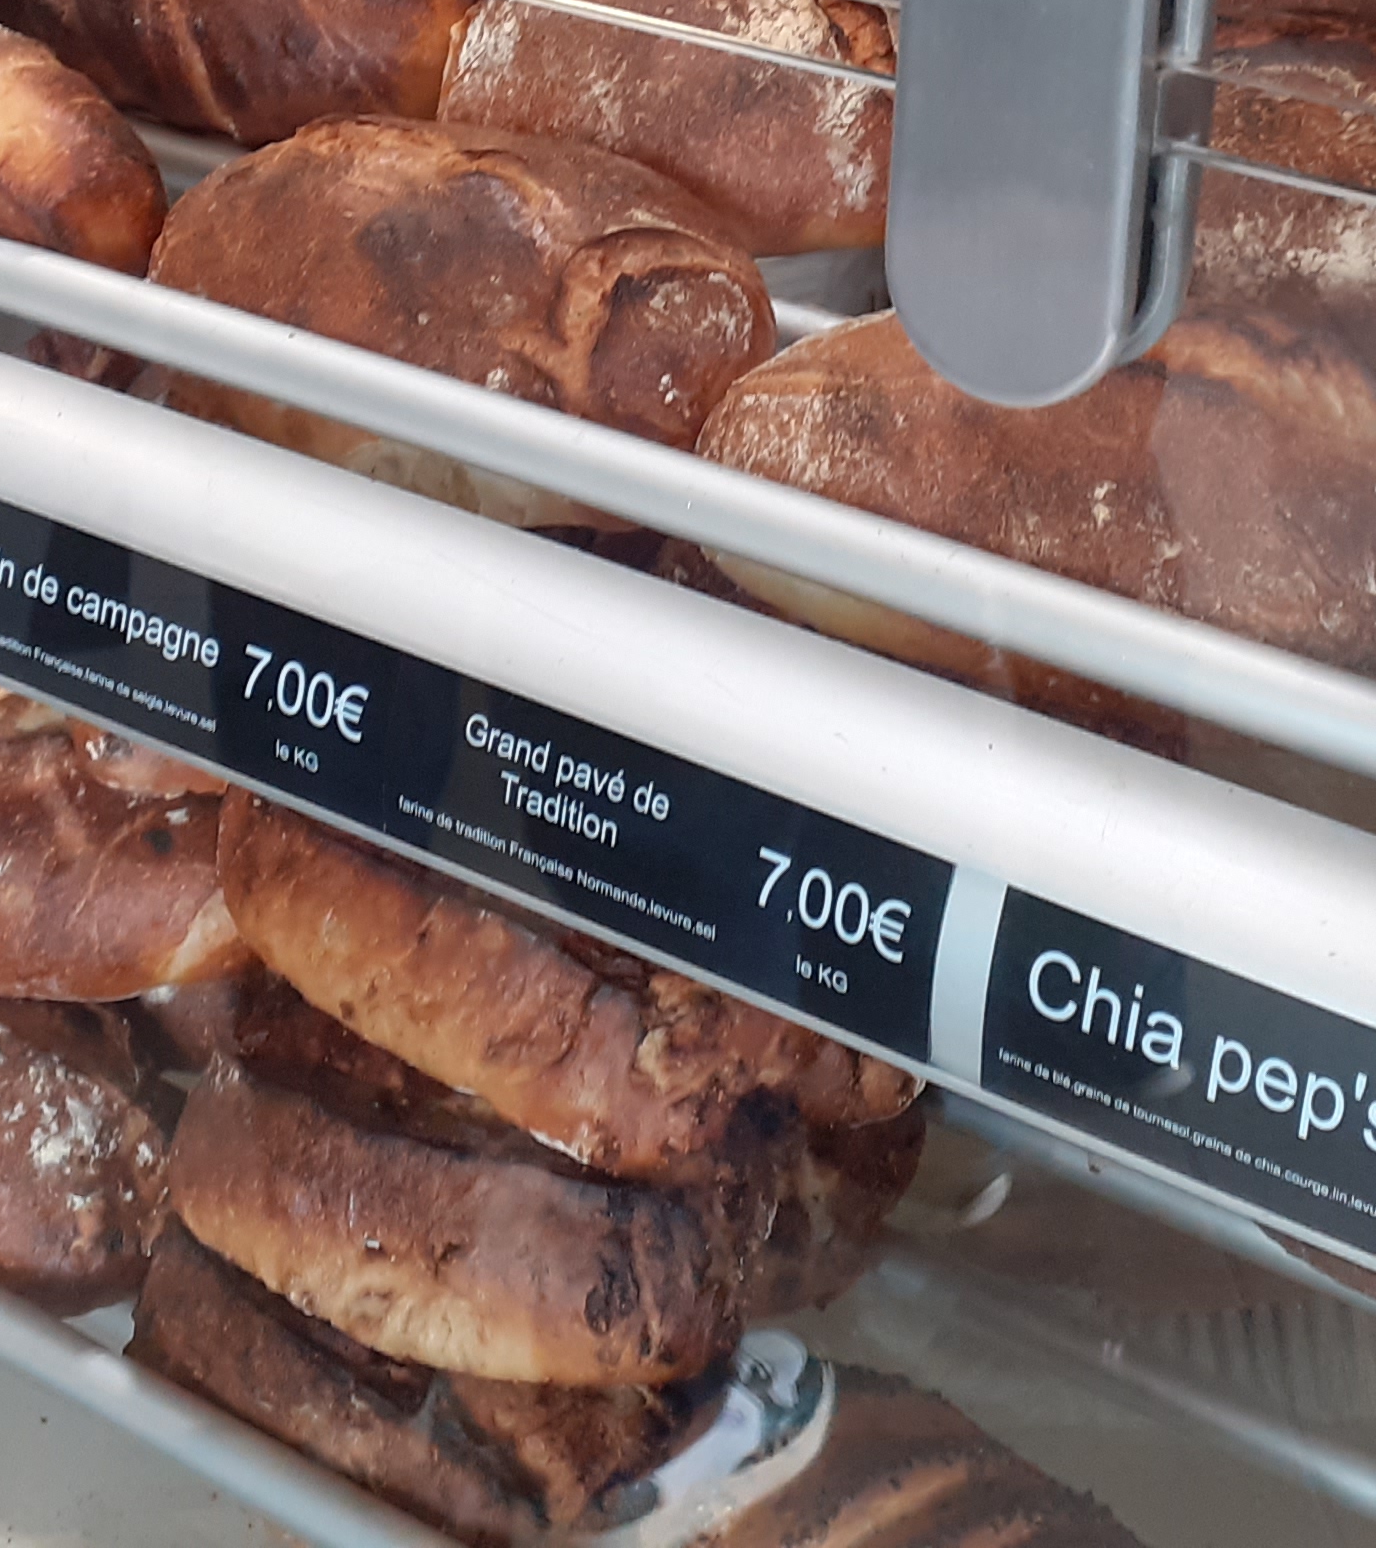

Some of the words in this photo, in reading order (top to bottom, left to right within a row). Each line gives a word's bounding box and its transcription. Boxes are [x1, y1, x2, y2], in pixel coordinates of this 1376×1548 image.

[23, 563, 59, 605] de
[66, 586, 220, 668] campagne
[244, 643, 369, 743] 7,00€
[275, 738, 289, 762] le
[293, 745, 318, 773] KG
[465, 713, 551, 773] Grand
[555, 754, 625, 804] pavé
[633, 780, 670, 821] de
[399, 794, 434, 823] farine
[436, 812, 453, 831] de
[456, 819, 506, 854] tradition
[509, 840, 573, 882] Française
[500, 770, 618, 848] Tradition
[758, 846, 912, 964] 7,00€
[796, 954, 812, 979] le
[818, 963, 848, 994] KG
[1028, 949, 1184, 1071] Chia
[998, 1047, 1032, 1072] farine
[1034, 1063, 1050, 1081] de
[1114, 1097, 1130, 1115] de
[1235, 1148, 1251, 1165] de
